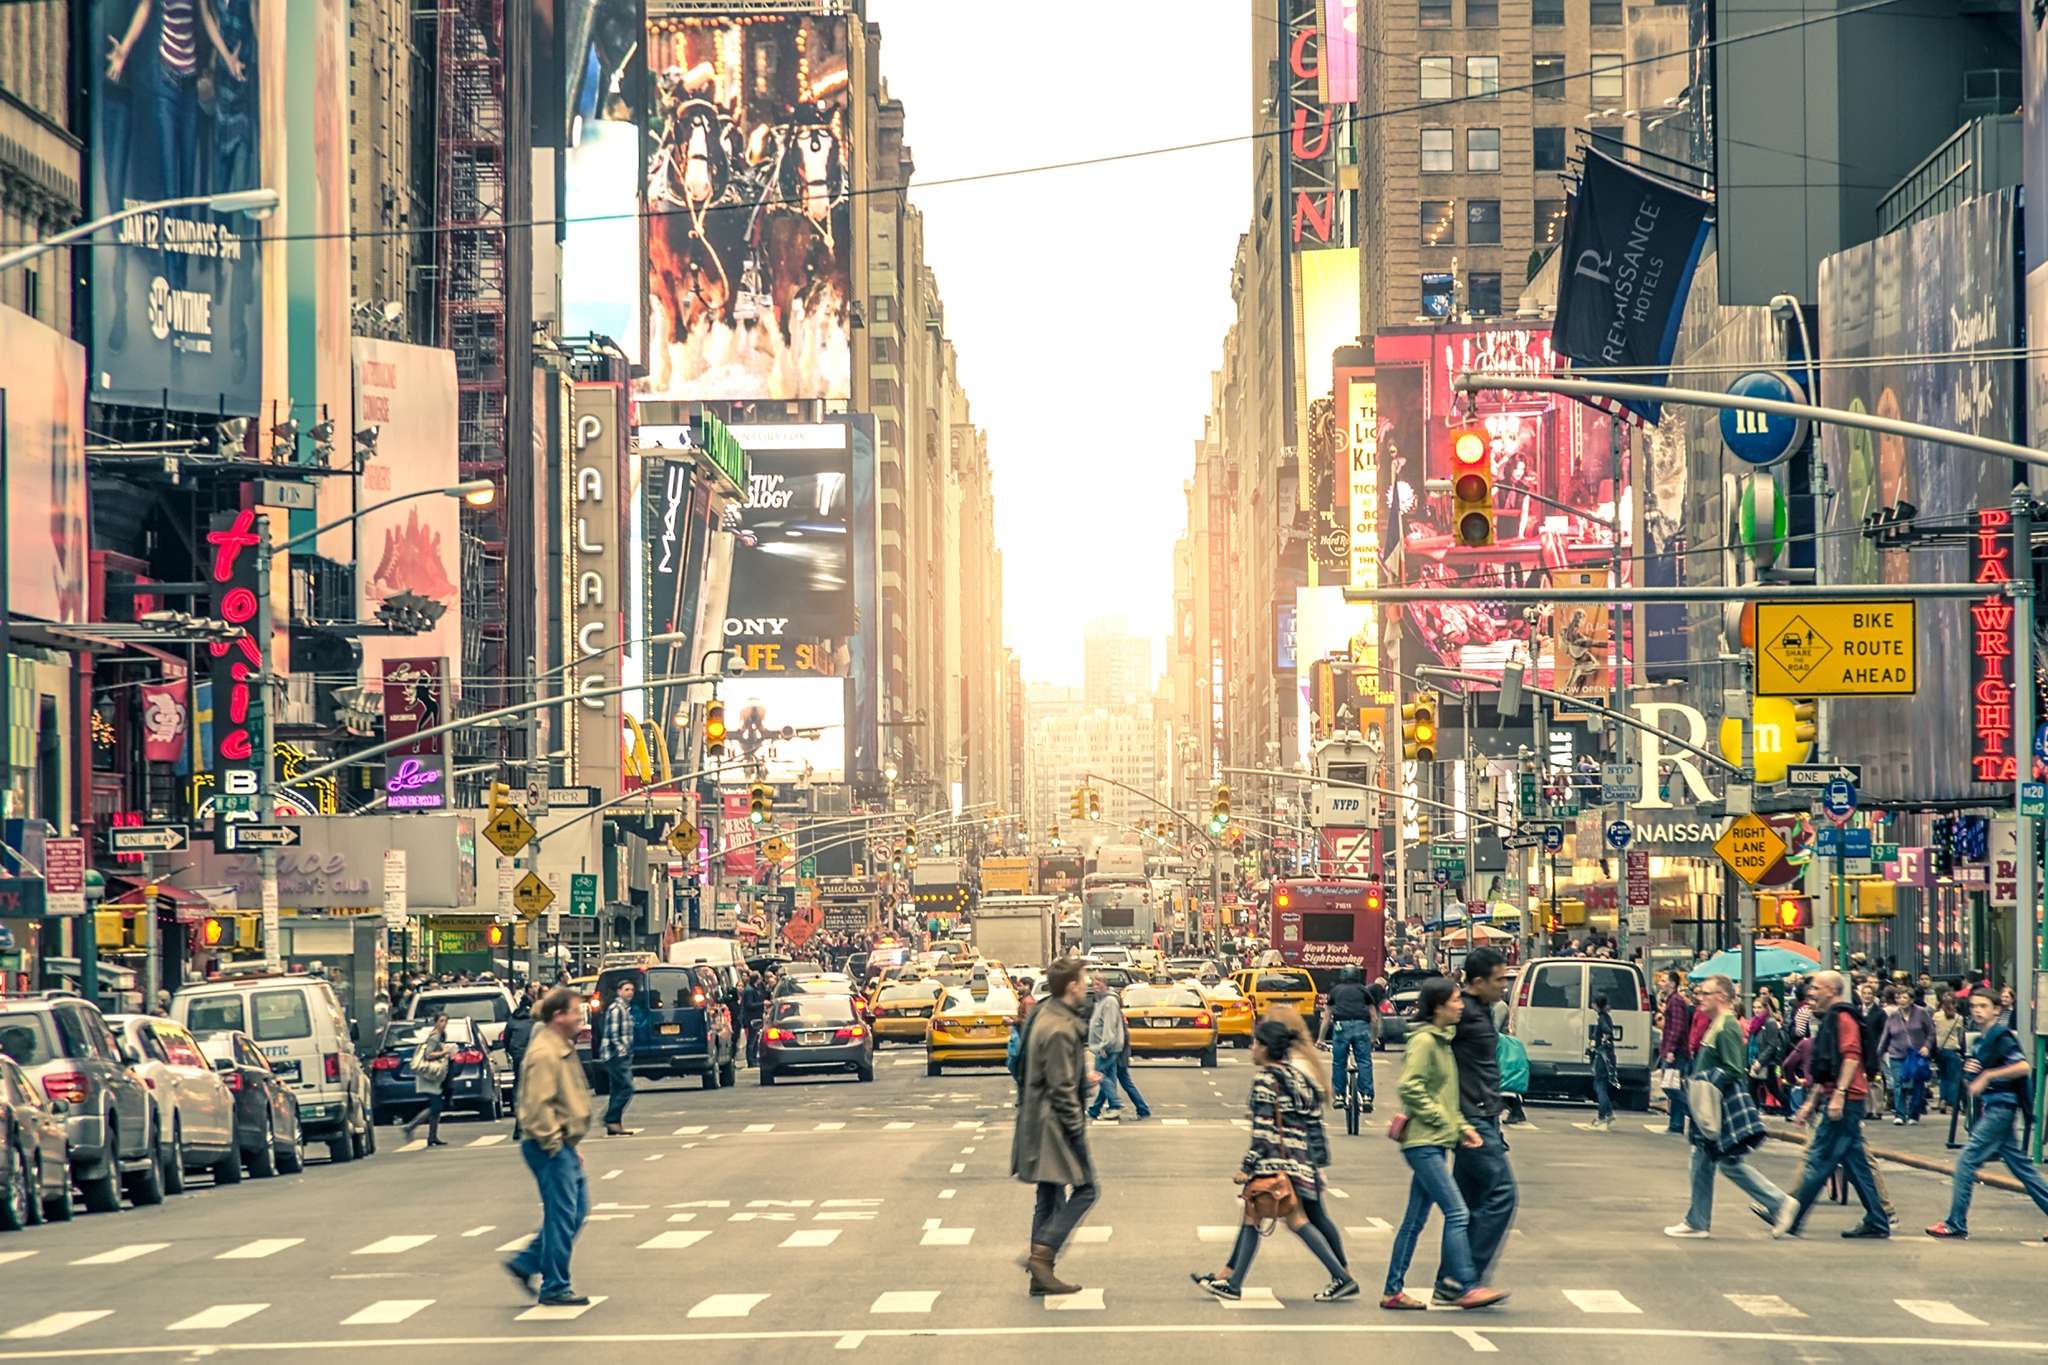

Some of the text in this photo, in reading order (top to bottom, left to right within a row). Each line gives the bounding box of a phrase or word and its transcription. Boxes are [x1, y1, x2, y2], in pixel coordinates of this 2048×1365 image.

[119, 213, 144, 247] JAN
[145, 214, 159, 250] 12
[164, 217, 218, 257] SUNDAYS
[1574, 249, 1613, 284] R
[1632, 256, 1664, 322] HOTELS
[148, 276, 212, 339] SHOWTIME
[577, 415, 606, 709] PALACE
[1853, 613, 1894, 628] BIKE
[722, 618, 788, 636] ONY
[1971, 509, 2013, 754] PLAWRIGHT
[1844, 640, 1904, 656] ROUTE
[1788, 663, 1810, 671] ROAD
[1842, 668, 1906, 683] AHEAD
[1582, 685, 1606, 694] OPEN
[1630, 703, 1722, 810] R
[1607, 766, 1633, 774] NYPD
[1797, 772, 1819, 781] ONE
[1332, 799, 1360, 811] NYPD
[244, 832, 263, 840] ONE
[1732, 827, 1765, 838] RIGHT
[121, 834, 176, 845] ONE WAY
[1734, 842, 1766, 853] LANE
[1735, 856, 1766, 868] ENDS
[1302, 943, 1350, 953] New York
[1302, 953, 1364, 965] Sightseeing
